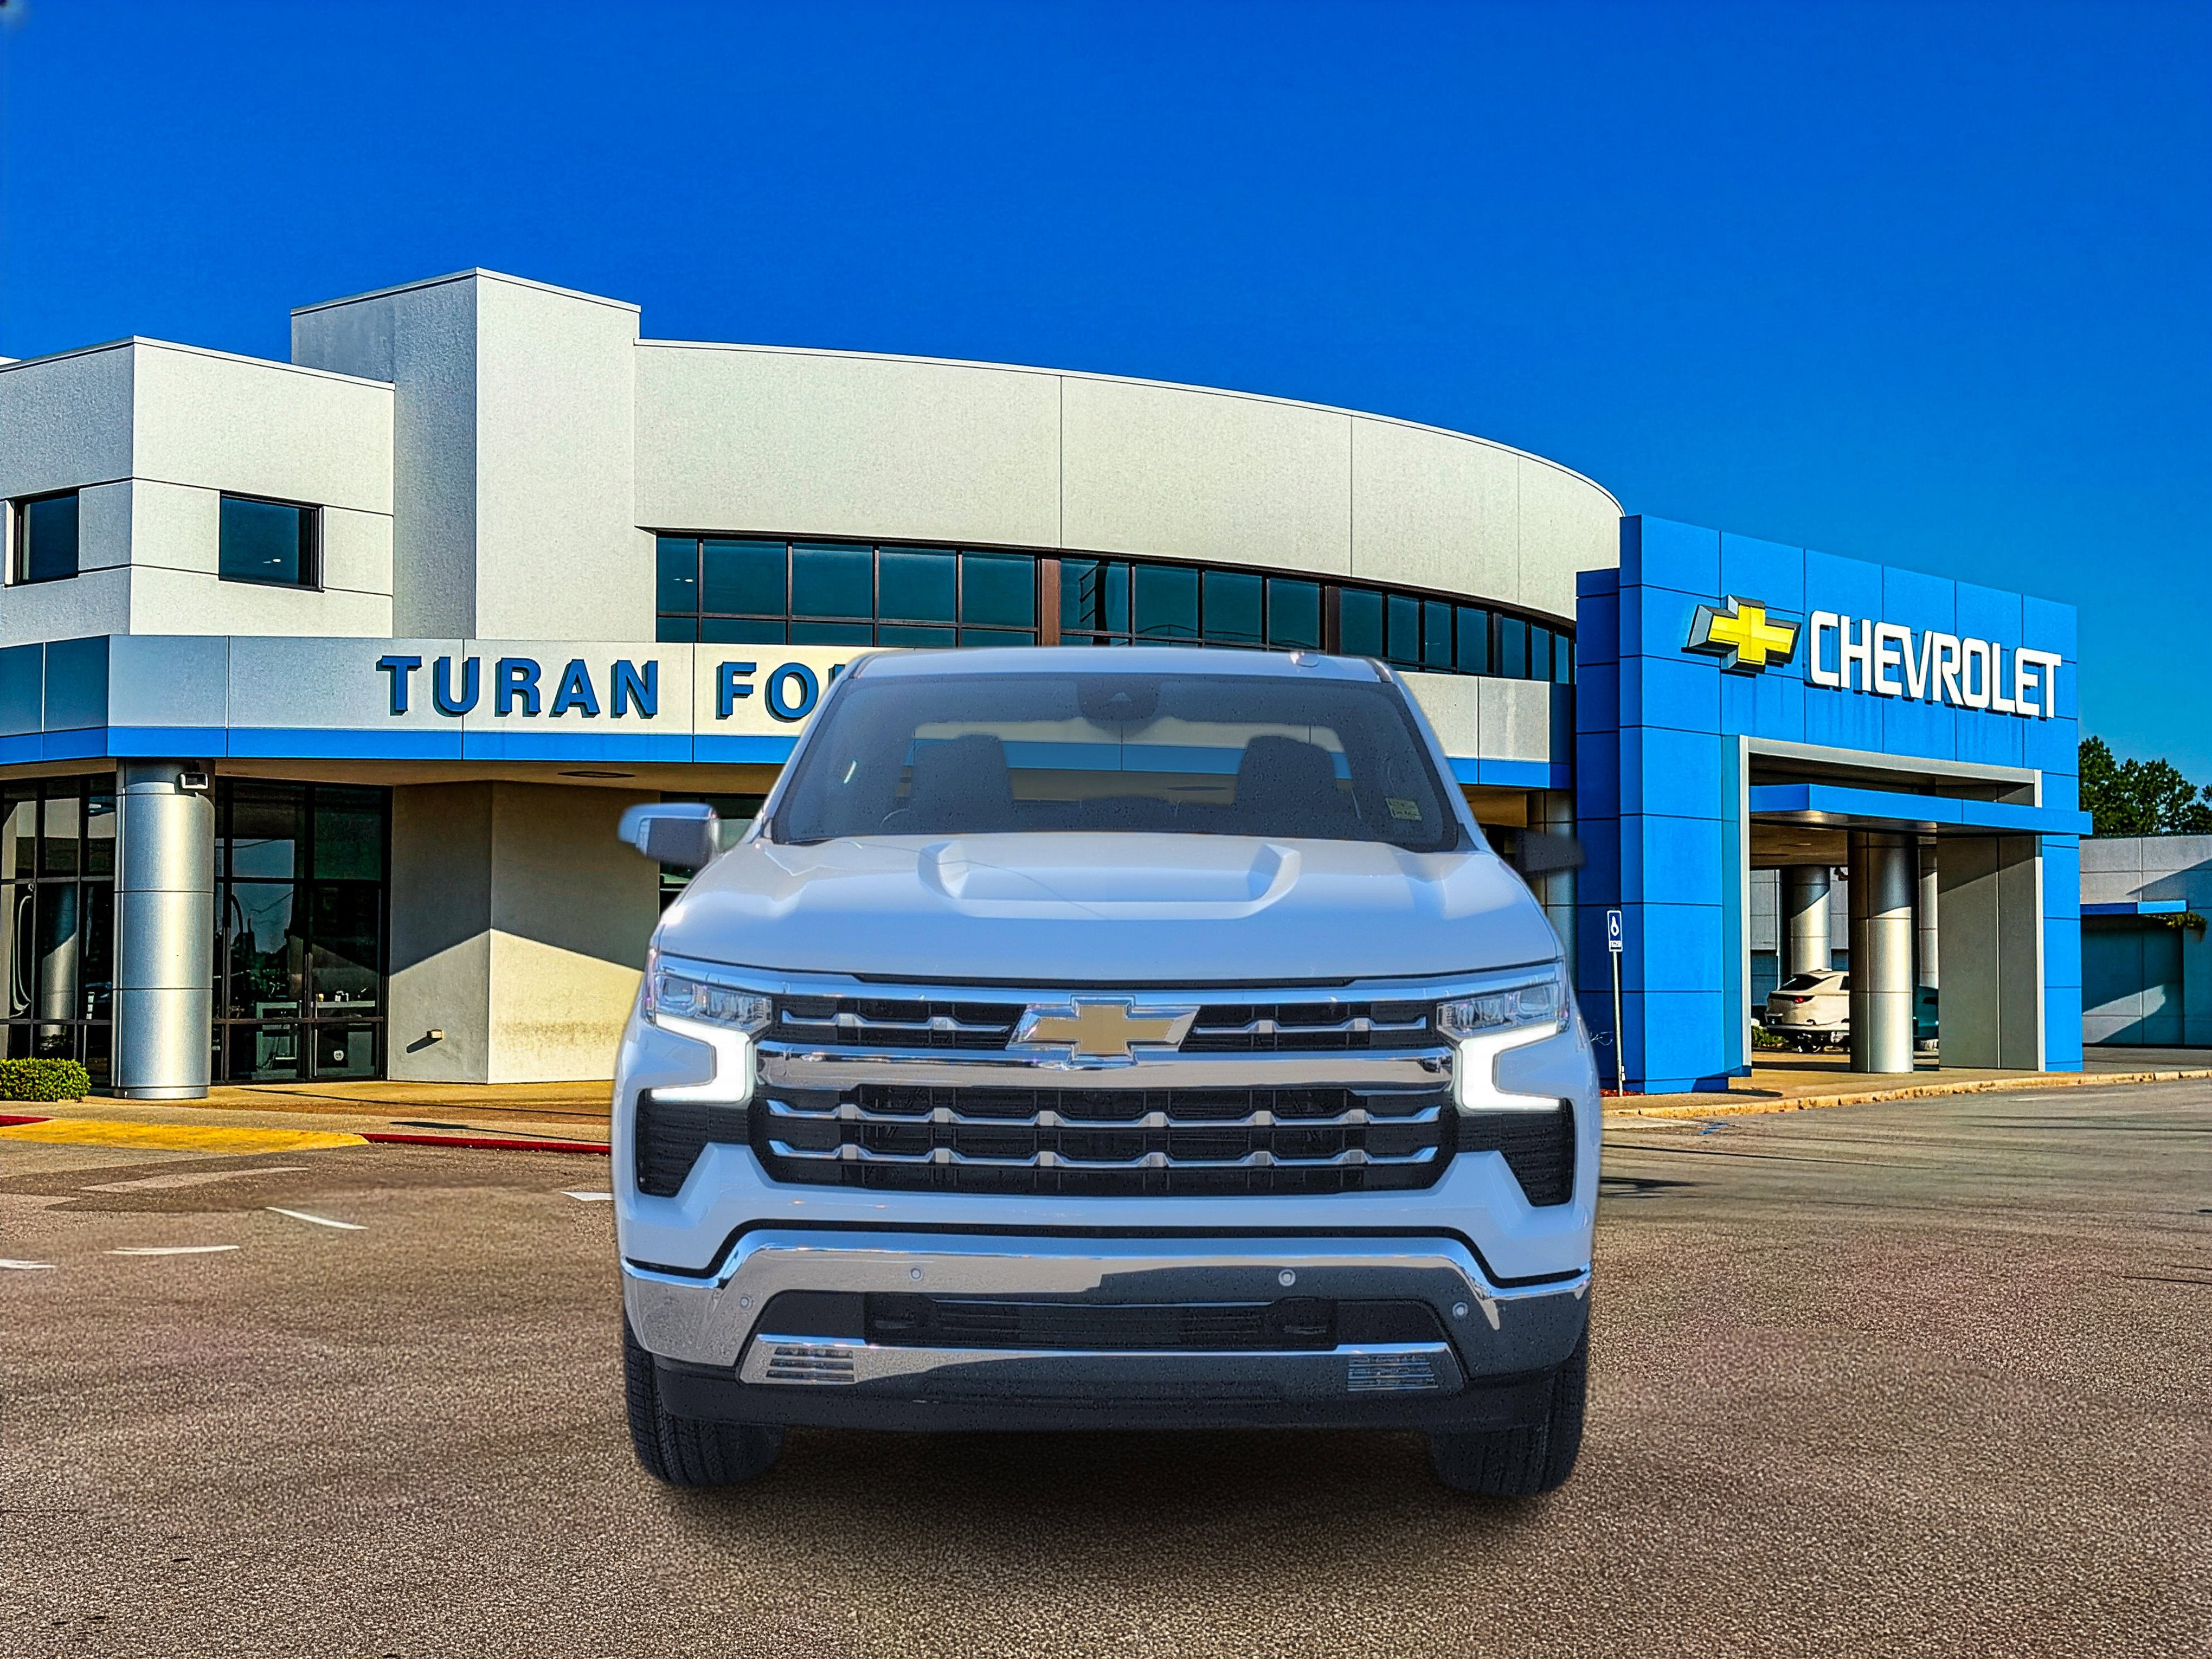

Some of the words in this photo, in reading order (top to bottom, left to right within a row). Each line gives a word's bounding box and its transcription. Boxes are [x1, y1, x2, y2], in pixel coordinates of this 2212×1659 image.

[376, 655, 659, 719] TURAN
[716, 661, 846, 723] FO
[1809, 610, 2062, 719] CHEVROLET
